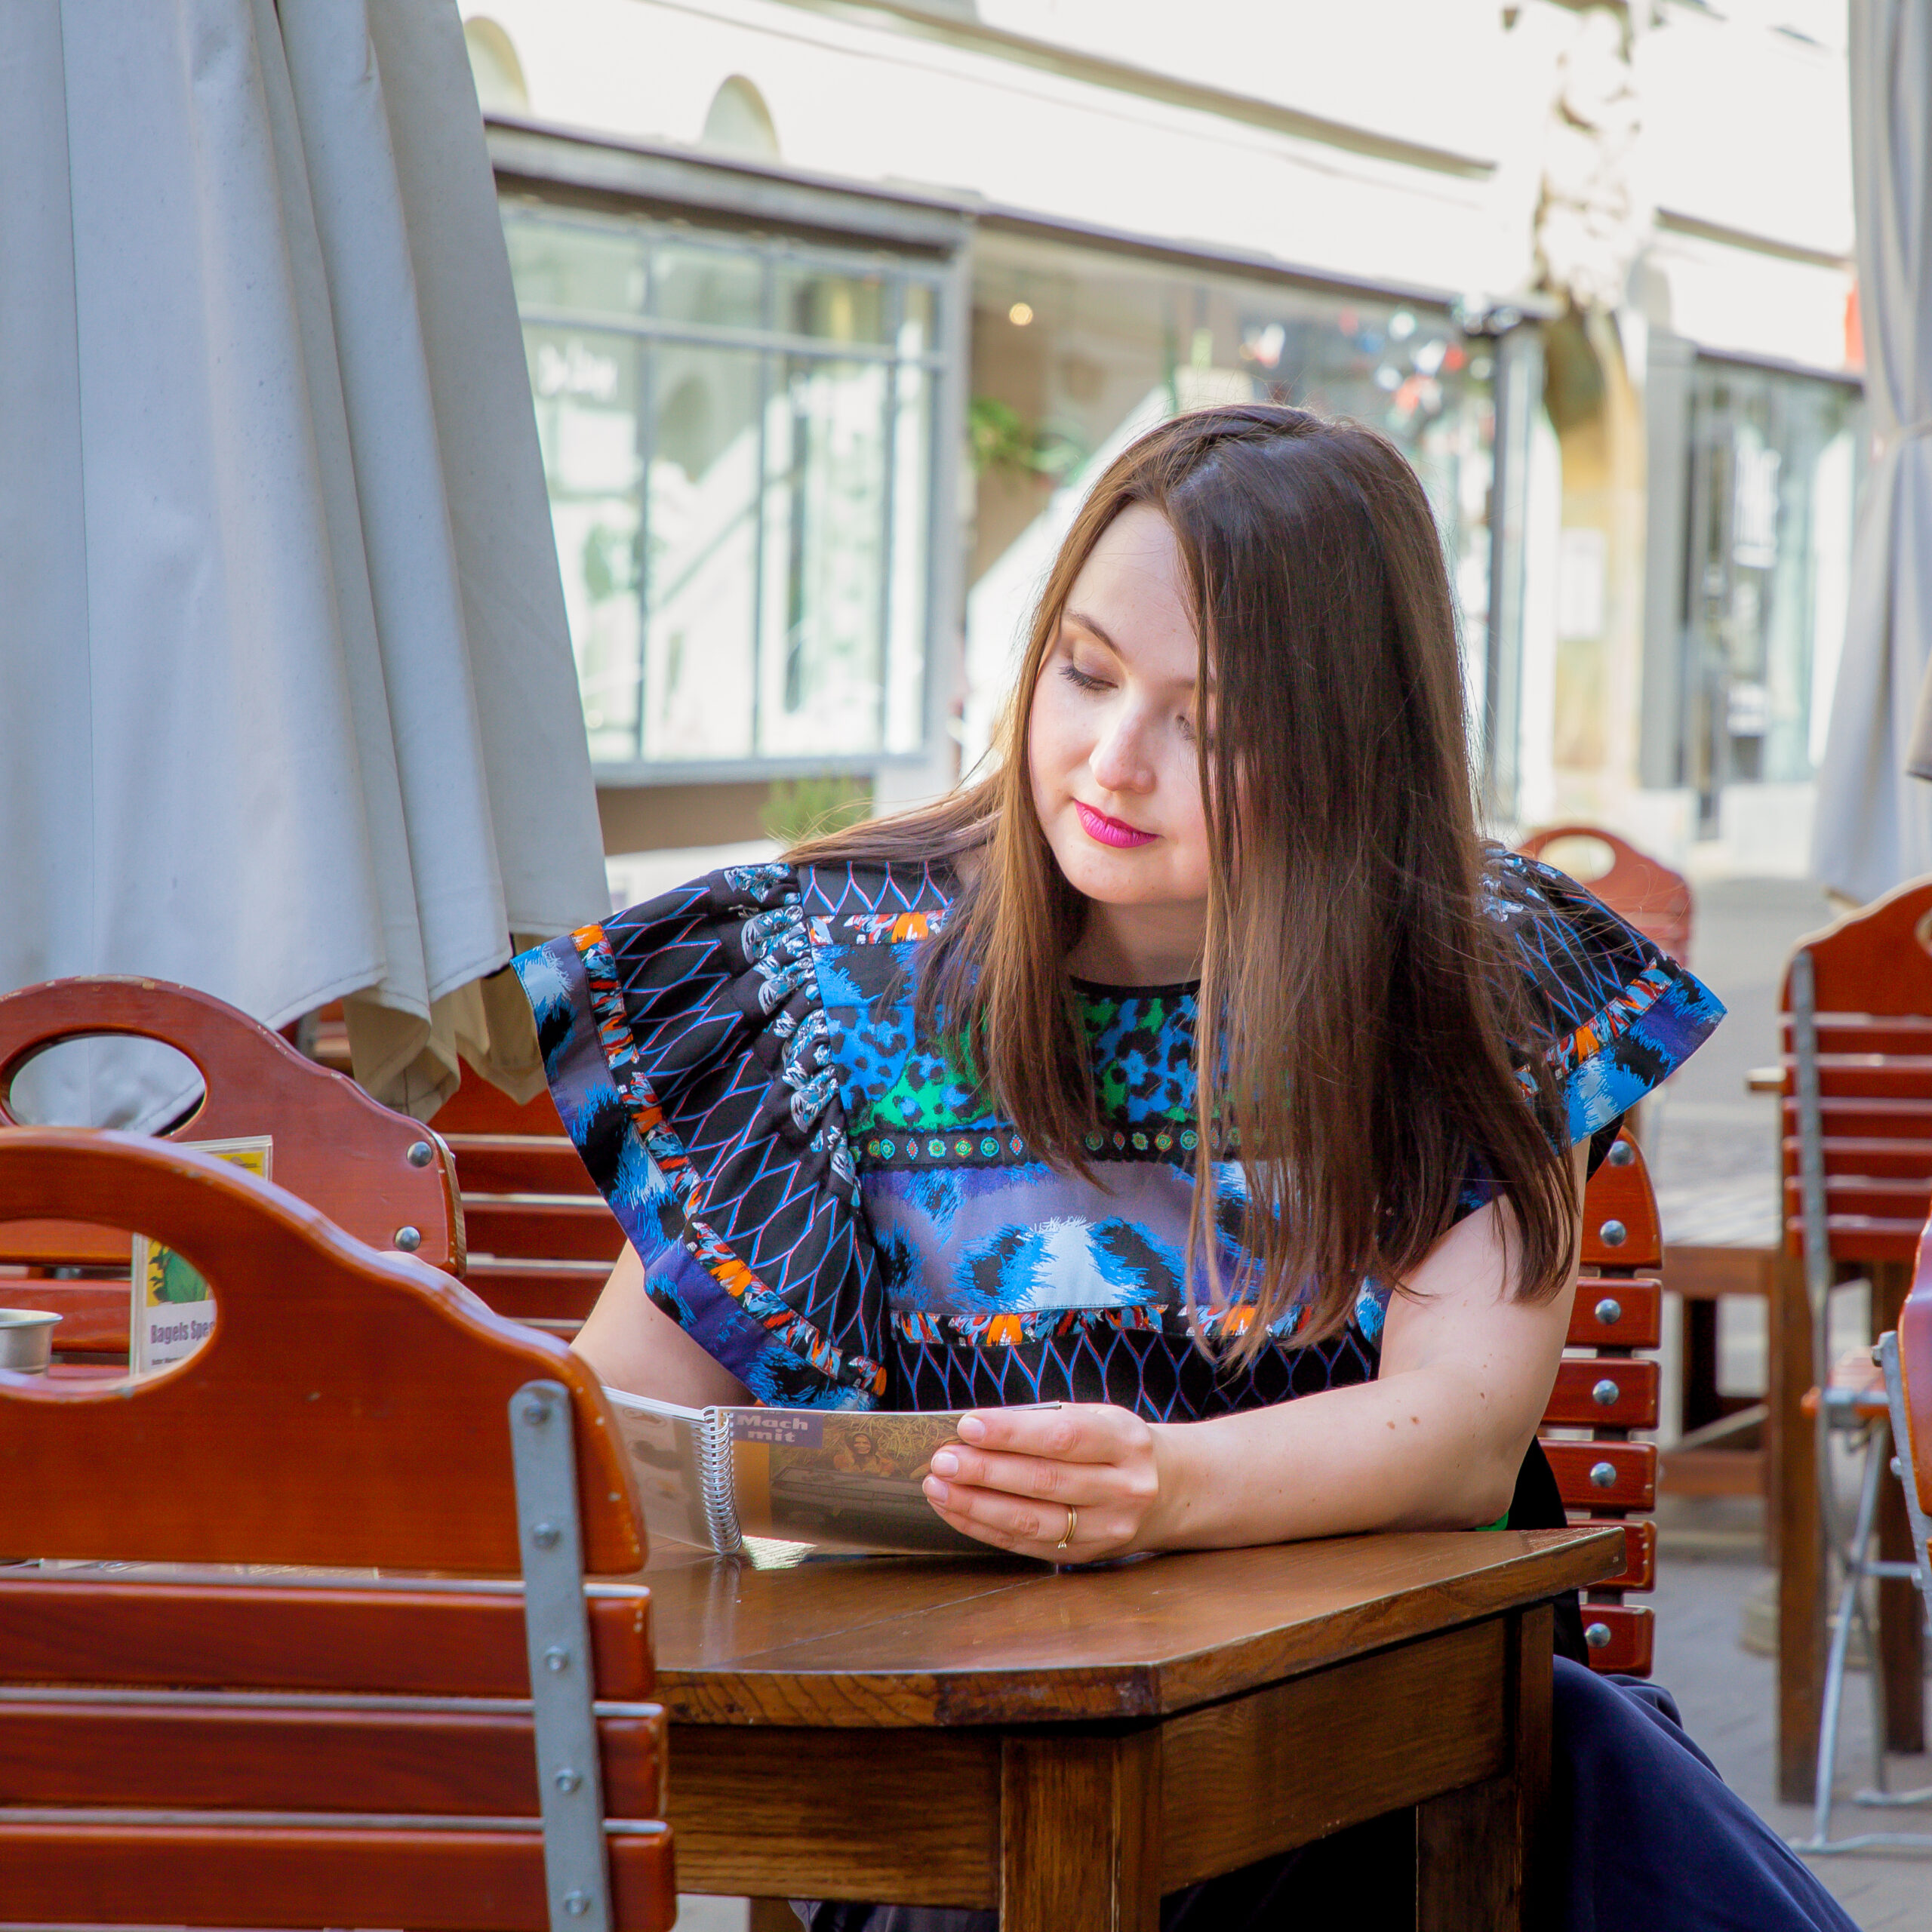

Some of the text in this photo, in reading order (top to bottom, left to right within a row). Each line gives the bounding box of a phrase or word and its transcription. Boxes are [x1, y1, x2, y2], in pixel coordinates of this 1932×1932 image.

[151, 1322, 188, 1345] Bagels
[737, 1414, 808, 1431] Mach
[748, 1429, 795, 1443] mit
